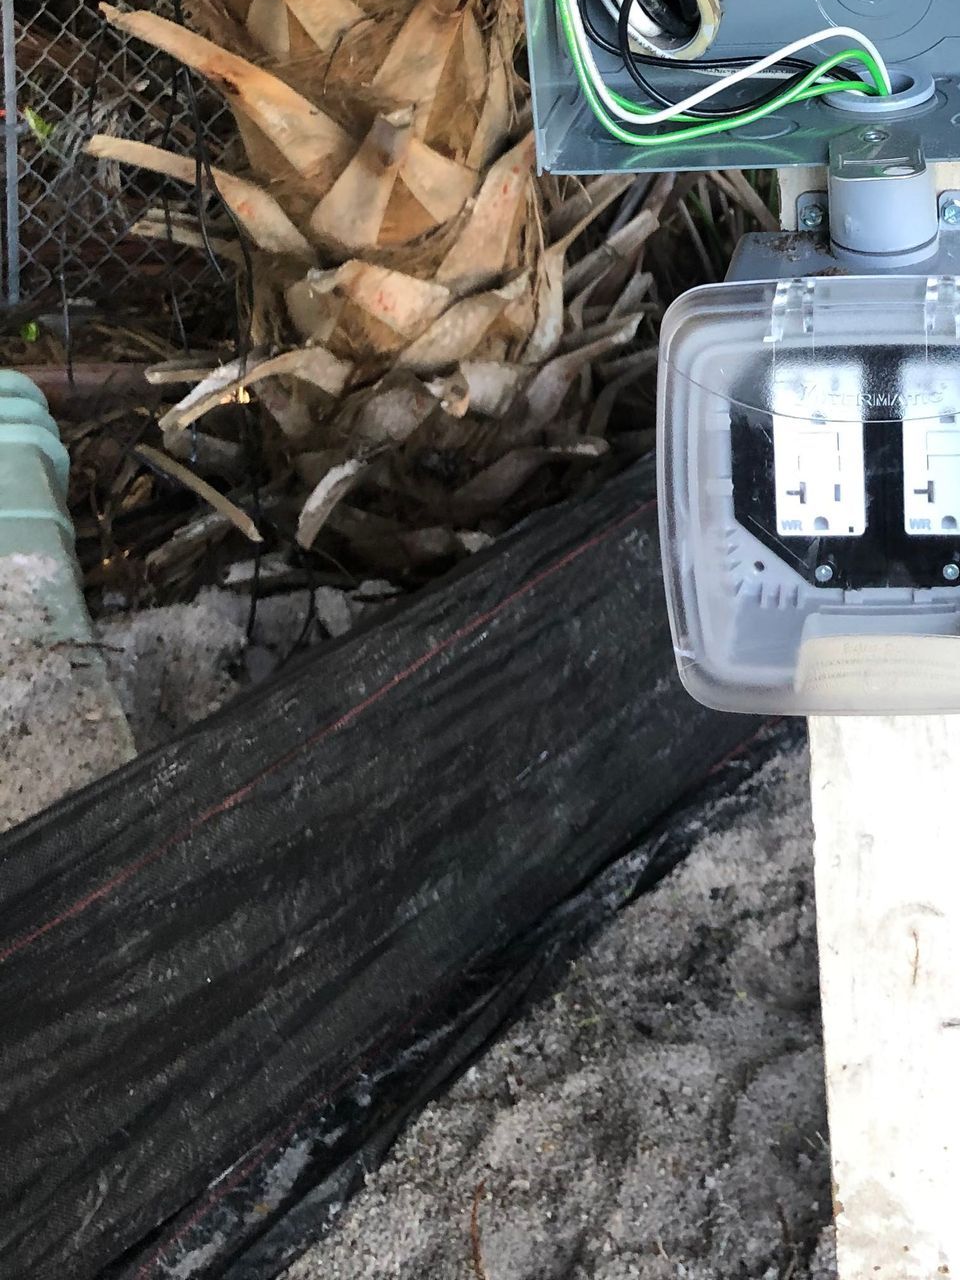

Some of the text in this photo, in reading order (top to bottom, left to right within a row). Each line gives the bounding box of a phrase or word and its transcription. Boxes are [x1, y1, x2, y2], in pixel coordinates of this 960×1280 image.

[798, 382, 945, 408] TERMATIC
[781, 519, 803, 531] WR
[909, 518, 931, 530] WR
